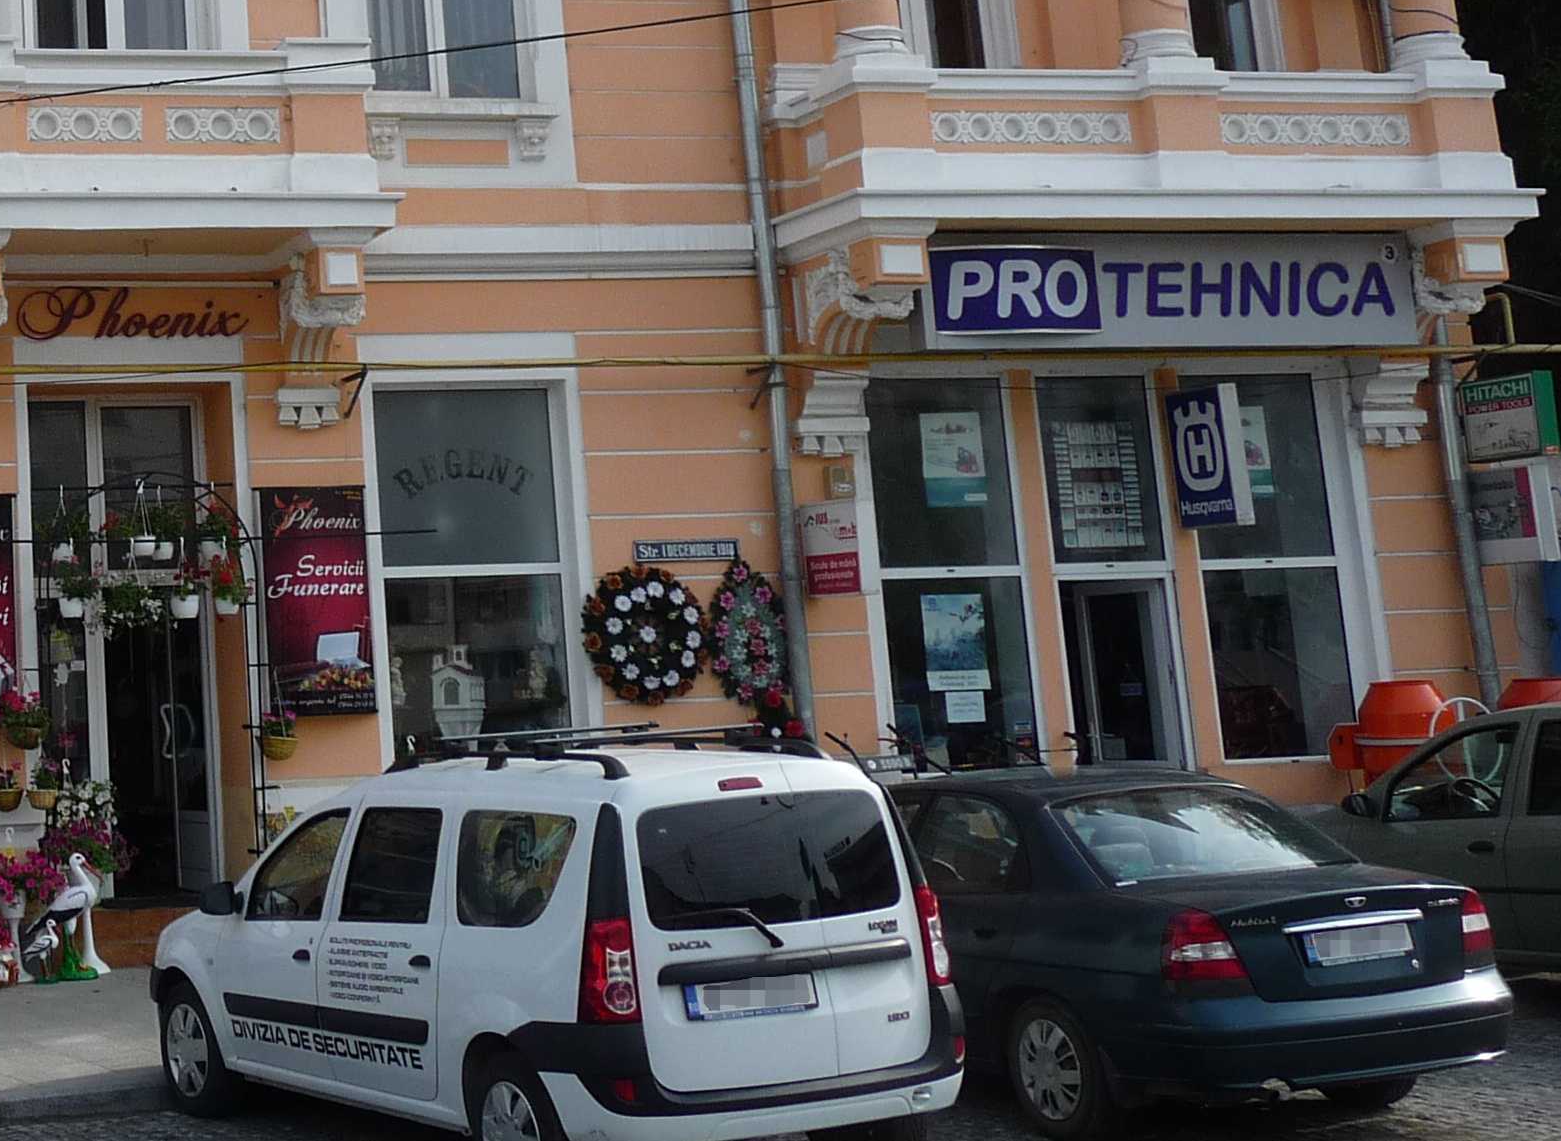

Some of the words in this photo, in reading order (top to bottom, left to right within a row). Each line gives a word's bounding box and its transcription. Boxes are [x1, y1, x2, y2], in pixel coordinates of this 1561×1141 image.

[1384, 246, 1395, 259] 3
[947, 259, 1089, 321] PRO
[1102, 261, 1396, 318] TEHNICA
[16, 286, 249, 341] Phoenix
[1466, 379, 1529, 403] HITACHI
[1468, 403, 1501, 414] POWER
[1502, 397, 1531, 410] TOOLS
[393, 448, 534, 500] REGENT
[283, 507, 361, 531] Phoenix
[1180, 498, 1234, 517] Husqvarna
[638, 544, 660, 558] Str.
[296, 554, 365, 578] Servicii
[267, 573, 365, 599] Funerare
[667, 939, 713, 952] DACIA
[231, 1018, 288, 1047] DIVIZIA
[288, 1028, 312, 1051] DE
[312, 1032, 424, 1071] SECURITATE
